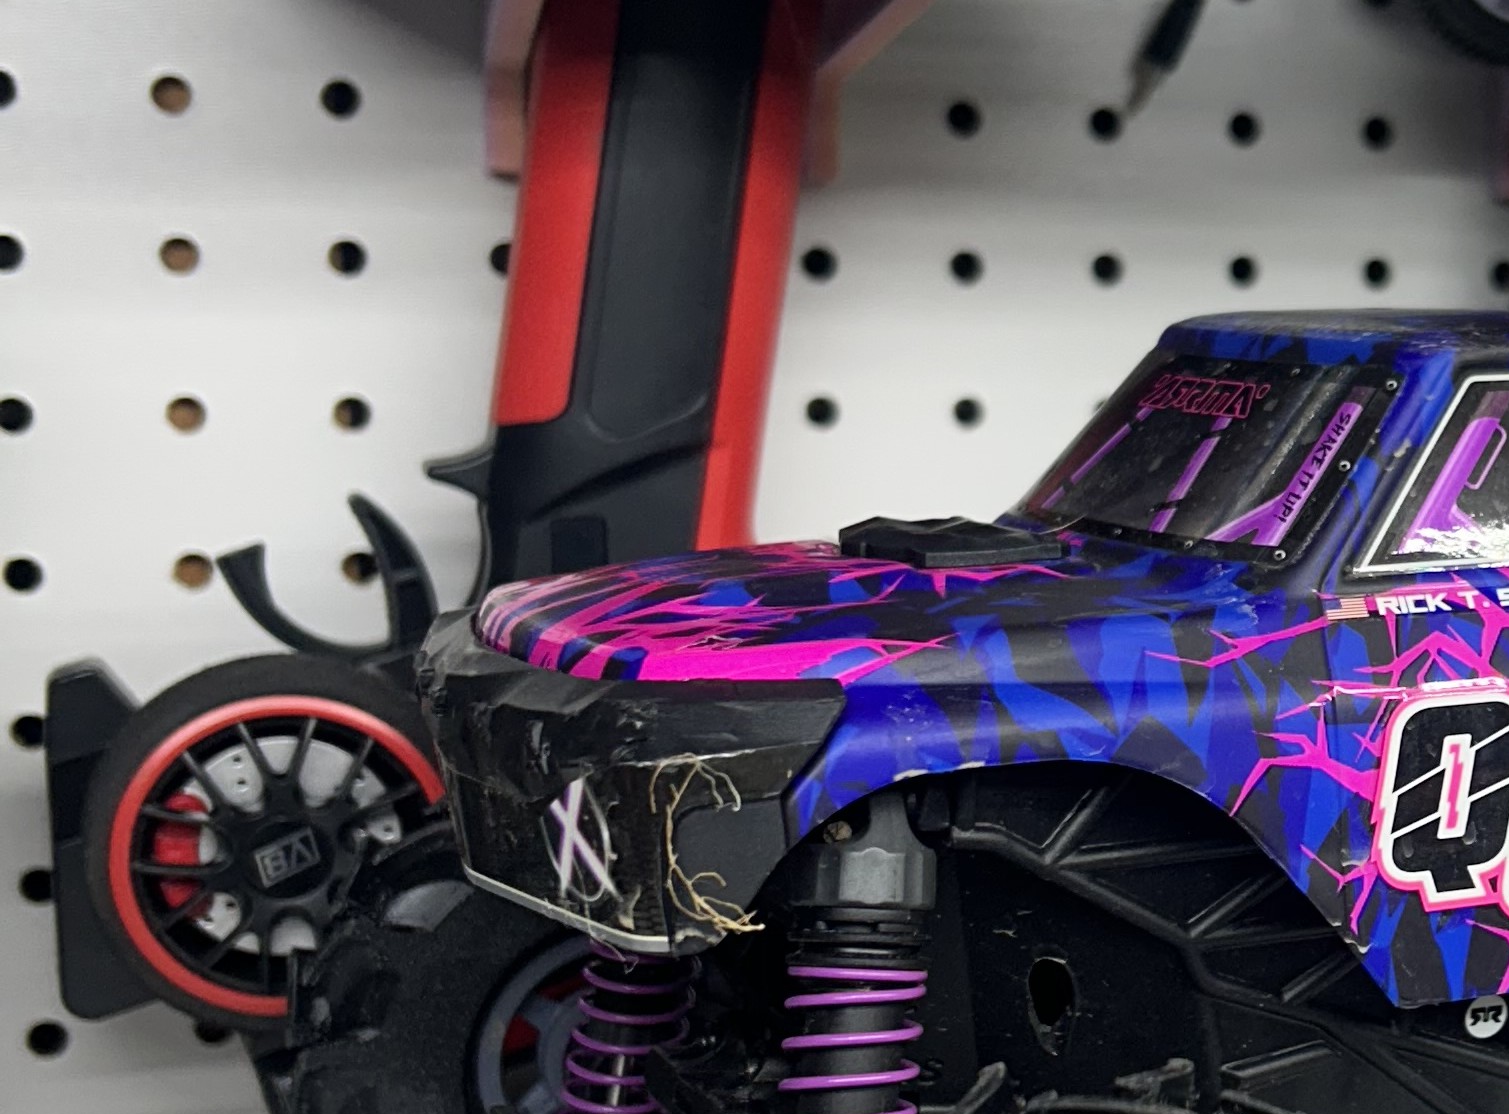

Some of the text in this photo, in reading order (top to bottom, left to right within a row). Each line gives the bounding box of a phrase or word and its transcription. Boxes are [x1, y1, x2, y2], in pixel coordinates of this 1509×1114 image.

[1273, 411, 1353, 524] SHAKE IT UP!
[1376, 593, 1452, 615] RICK
[1457, 591, 1490, 608] T.
